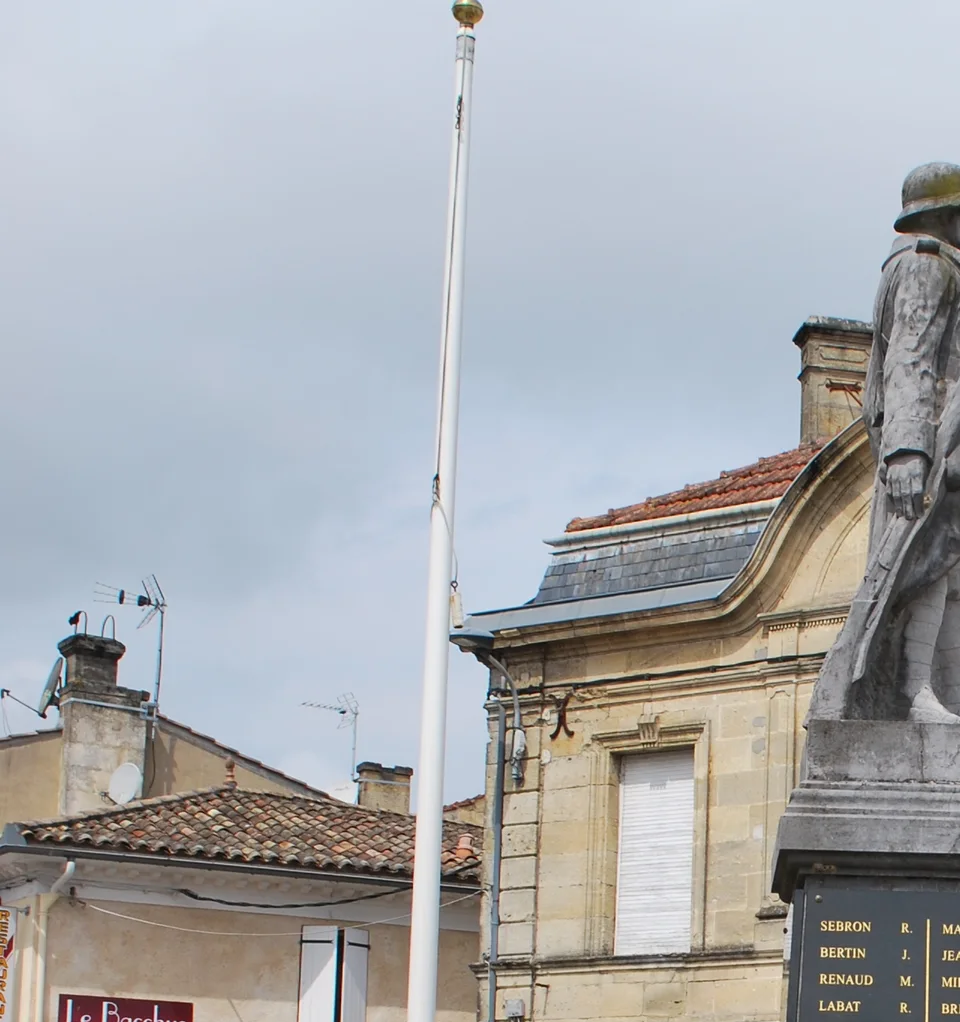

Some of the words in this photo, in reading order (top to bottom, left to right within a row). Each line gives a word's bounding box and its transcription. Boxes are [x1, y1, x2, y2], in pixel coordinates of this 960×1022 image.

[821, 921, 871, 932] SEBRON
[901, 922, 913, 934] R.
[820, 947, 865, 959] BERTIN
[902, 949, 910, 961] J.
[819, 973, 873, 986] RENAUD
[900, 975, 915, 988] M.
[819, 1001, 859, 1012] LABAT
[900, 1002, 912, 1014] R.
